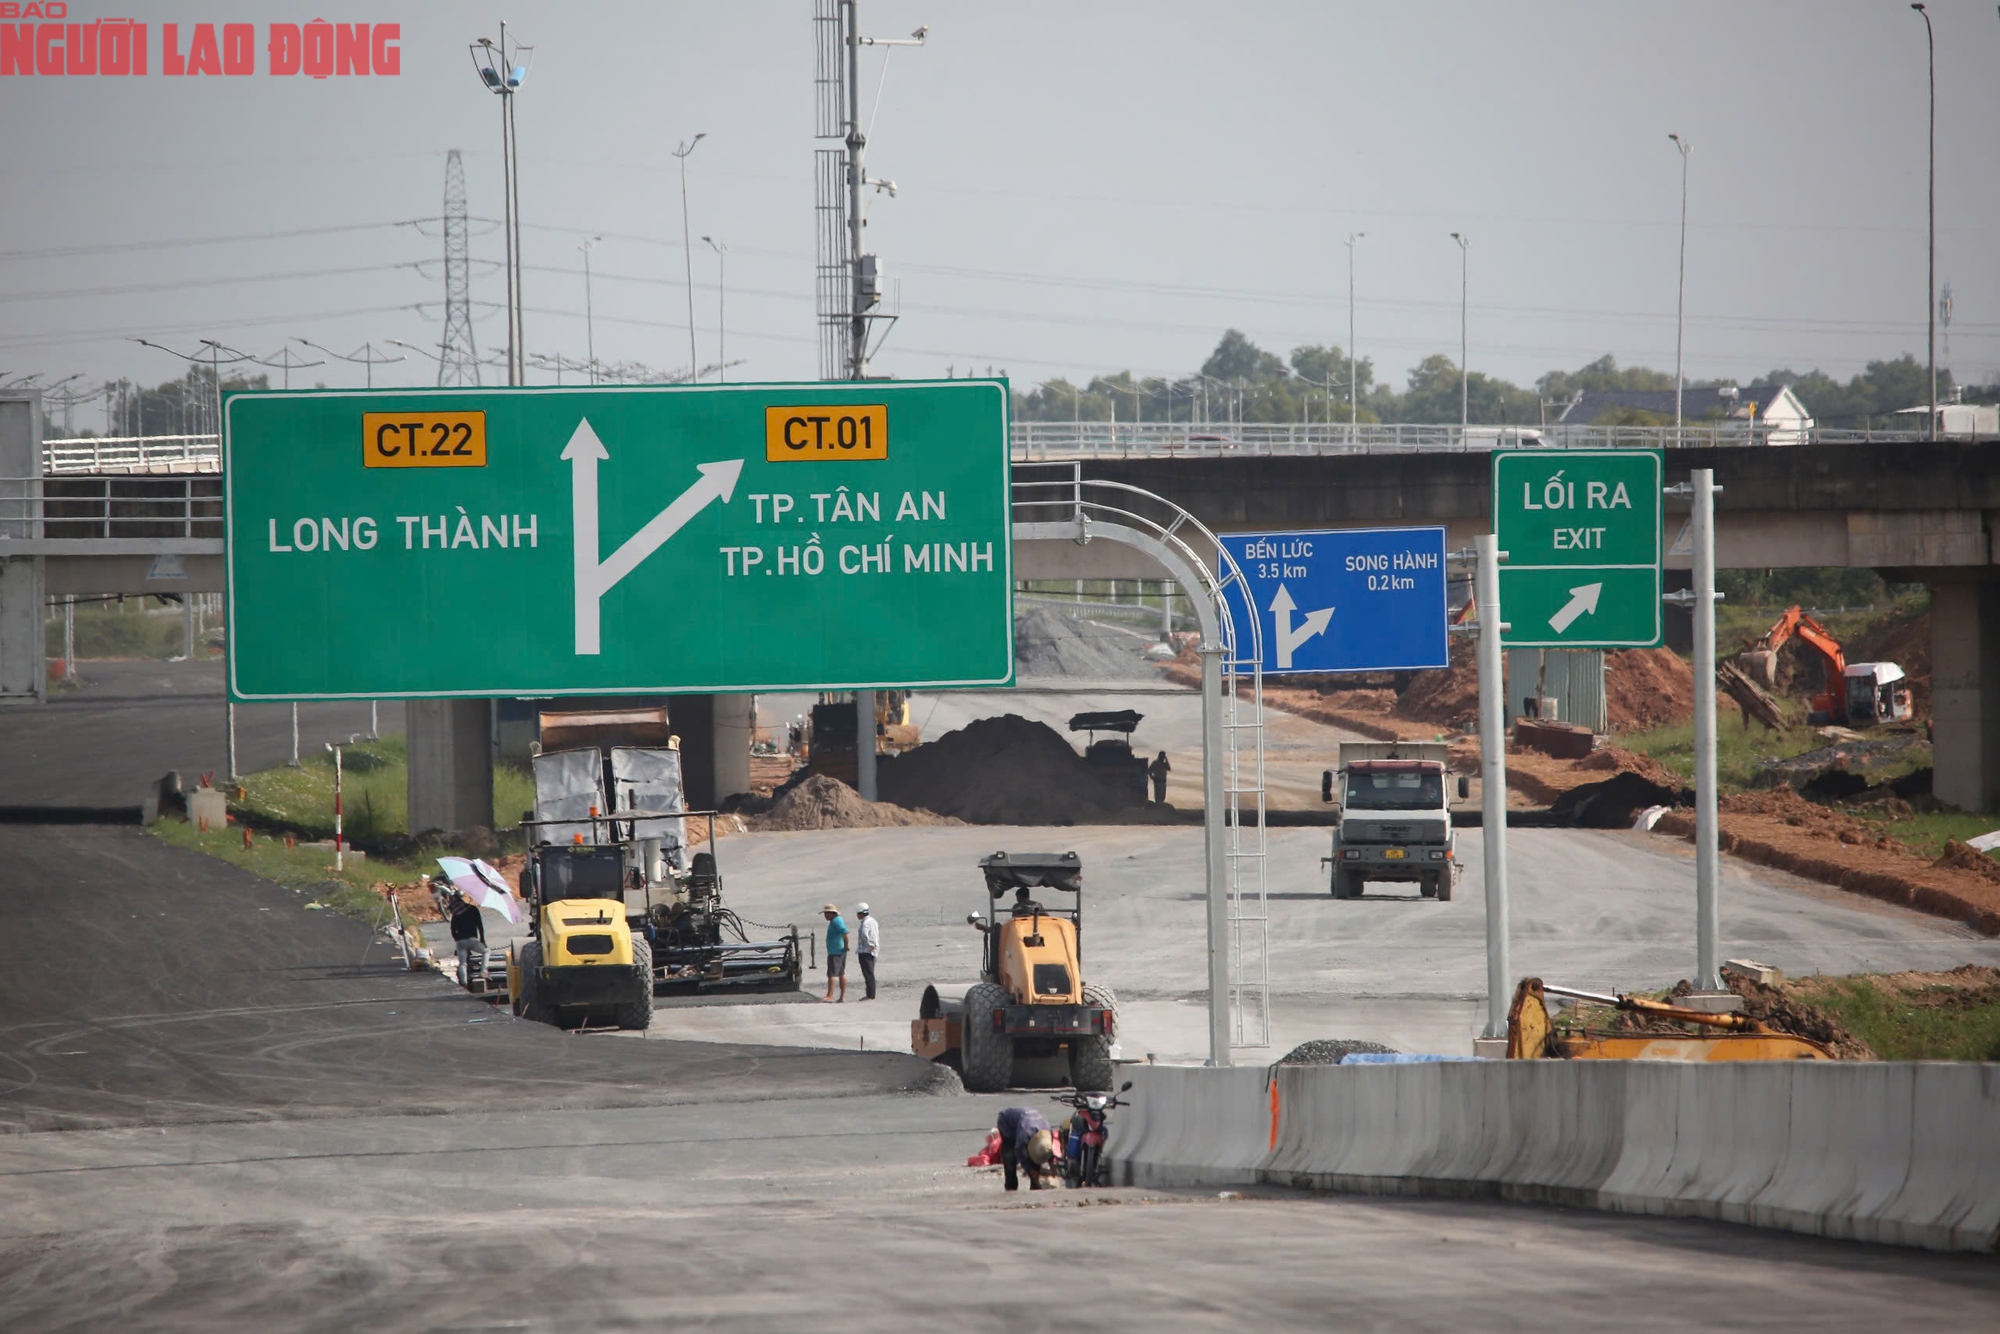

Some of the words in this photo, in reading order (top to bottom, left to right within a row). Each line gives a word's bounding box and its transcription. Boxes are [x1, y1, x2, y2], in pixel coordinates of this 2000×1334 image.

[377, 423, 472, 457] CT.22
[785, 416, 871, 450] CT.01
[1524, 470, 1574, 509] LỐI
[1588, 482, 1631, 508] RA
[896, 491, 945, 521] AN
[270, 517, 377, 552] LONG
[397, 506, 537, 549] THÀNH
[1554, 528, 1606, 549] EXIT
[839, 535, 893, 574] CHÍ
[904, 542, 992, 573] MINH
[1245, 536, 1276, 560] BẾN
[1283, 539, 1312, 558] LỨC
[1346, 555, 1388, 571] SONG
[1394, 550, 1437, 569] HÀNH
[1259, 564, 1278, 578] 3.5
[1284, 563, 1306, 577] km
[1368, 575, 1388, 590] 0.2
[1392, 575, 1413, 589] km
